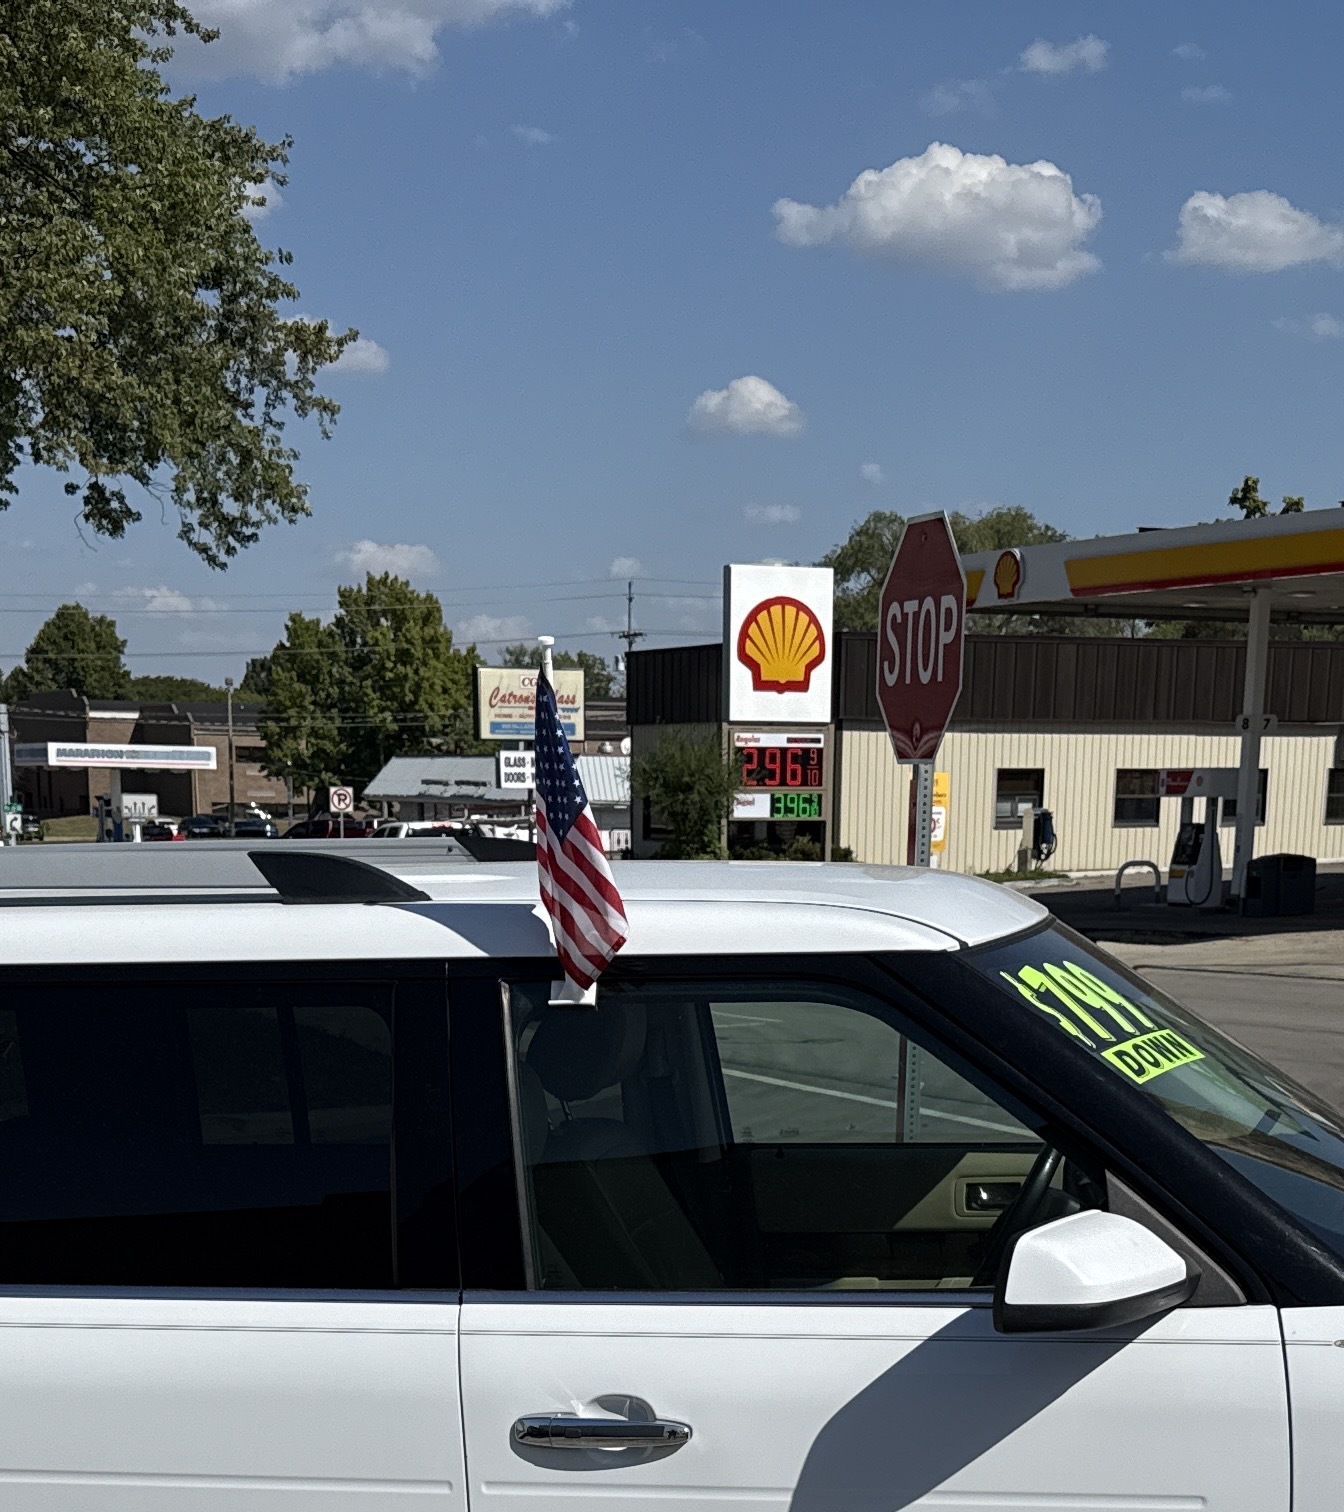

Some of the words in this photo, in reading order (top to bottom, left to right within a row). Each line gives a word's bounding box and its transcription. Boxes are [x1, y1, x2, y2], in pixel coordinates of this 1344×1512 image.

[883, 594, 957, 687] STOP
[488, 686, 536, 709] Catron's
[555, 689, 577, 706] lass
[1241, 717, 1250, 731] 8
[1262, 718, 1271, 730] 7
[504, 756, 526, 768] GLASS
[504, 772, 527, 783] DOORS
[1000, 960, 1158, 1049] $799
[1112, 1032, 1196, 1078] DOWN
